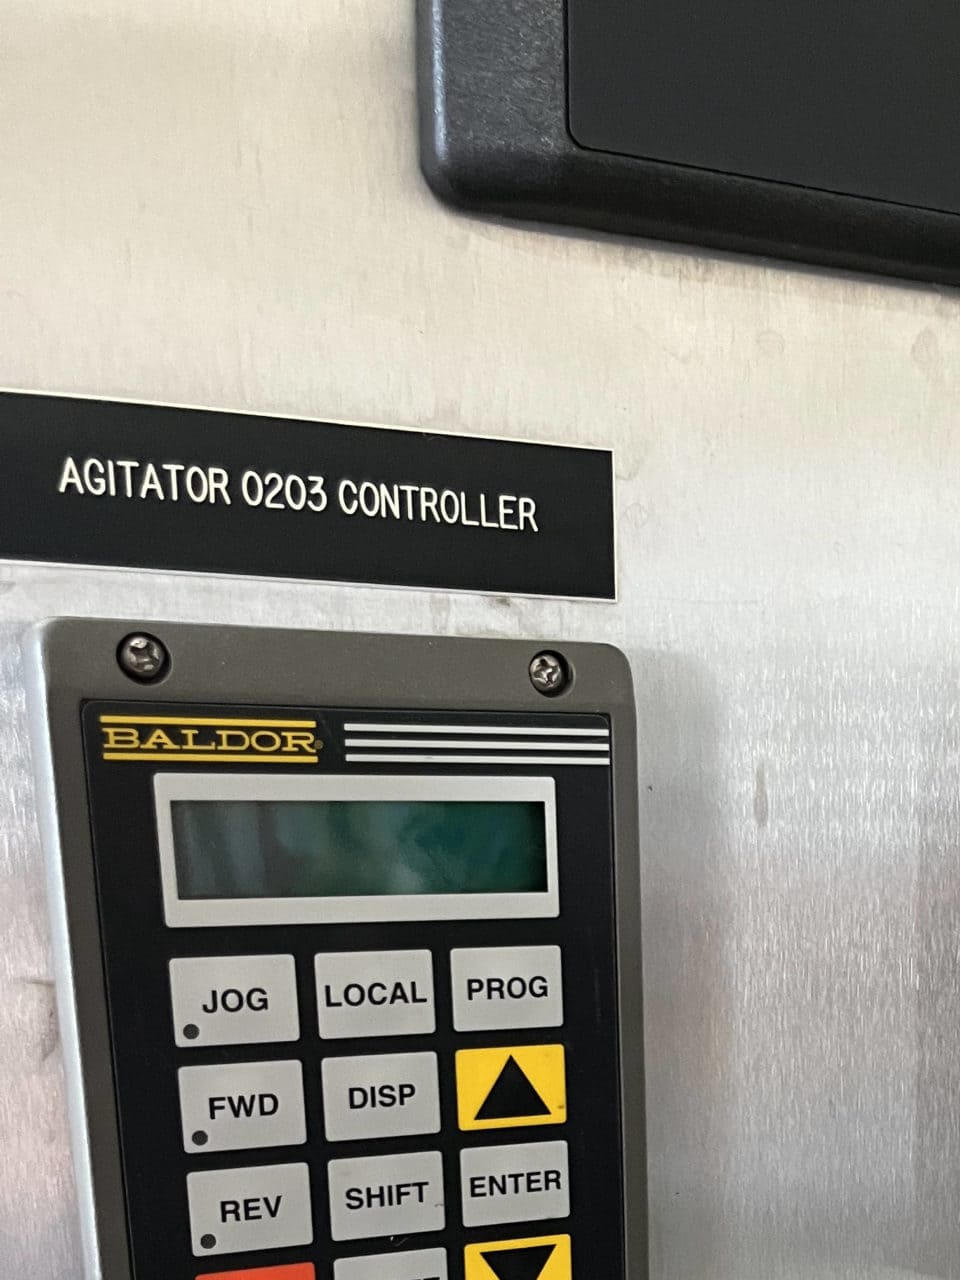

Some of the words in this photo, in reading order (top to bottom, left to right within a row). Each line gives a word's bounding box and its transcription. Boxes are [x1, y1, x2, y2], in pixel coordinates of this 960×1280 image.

[58, 456, 232, 506] AGITATOR
[241, 470, 328, 512] 0203
[338, 480, 540, 533] CONTROLLER
[101, 727, 318, 754] BALDOR
[202, 987, 270, 1014] JOG
[323, 981, 428, 1008] LOCAL
[465, 975, 550, 1001] PROG
[208, 1093, 280, 1120] FWD
[347, 1083, 416, 1110] DISP
[344, 1181, 430, 1210] SHIFT
[468, 1170, 562, 1198] ENTER
[219, 1196, 283, 1224] REV
